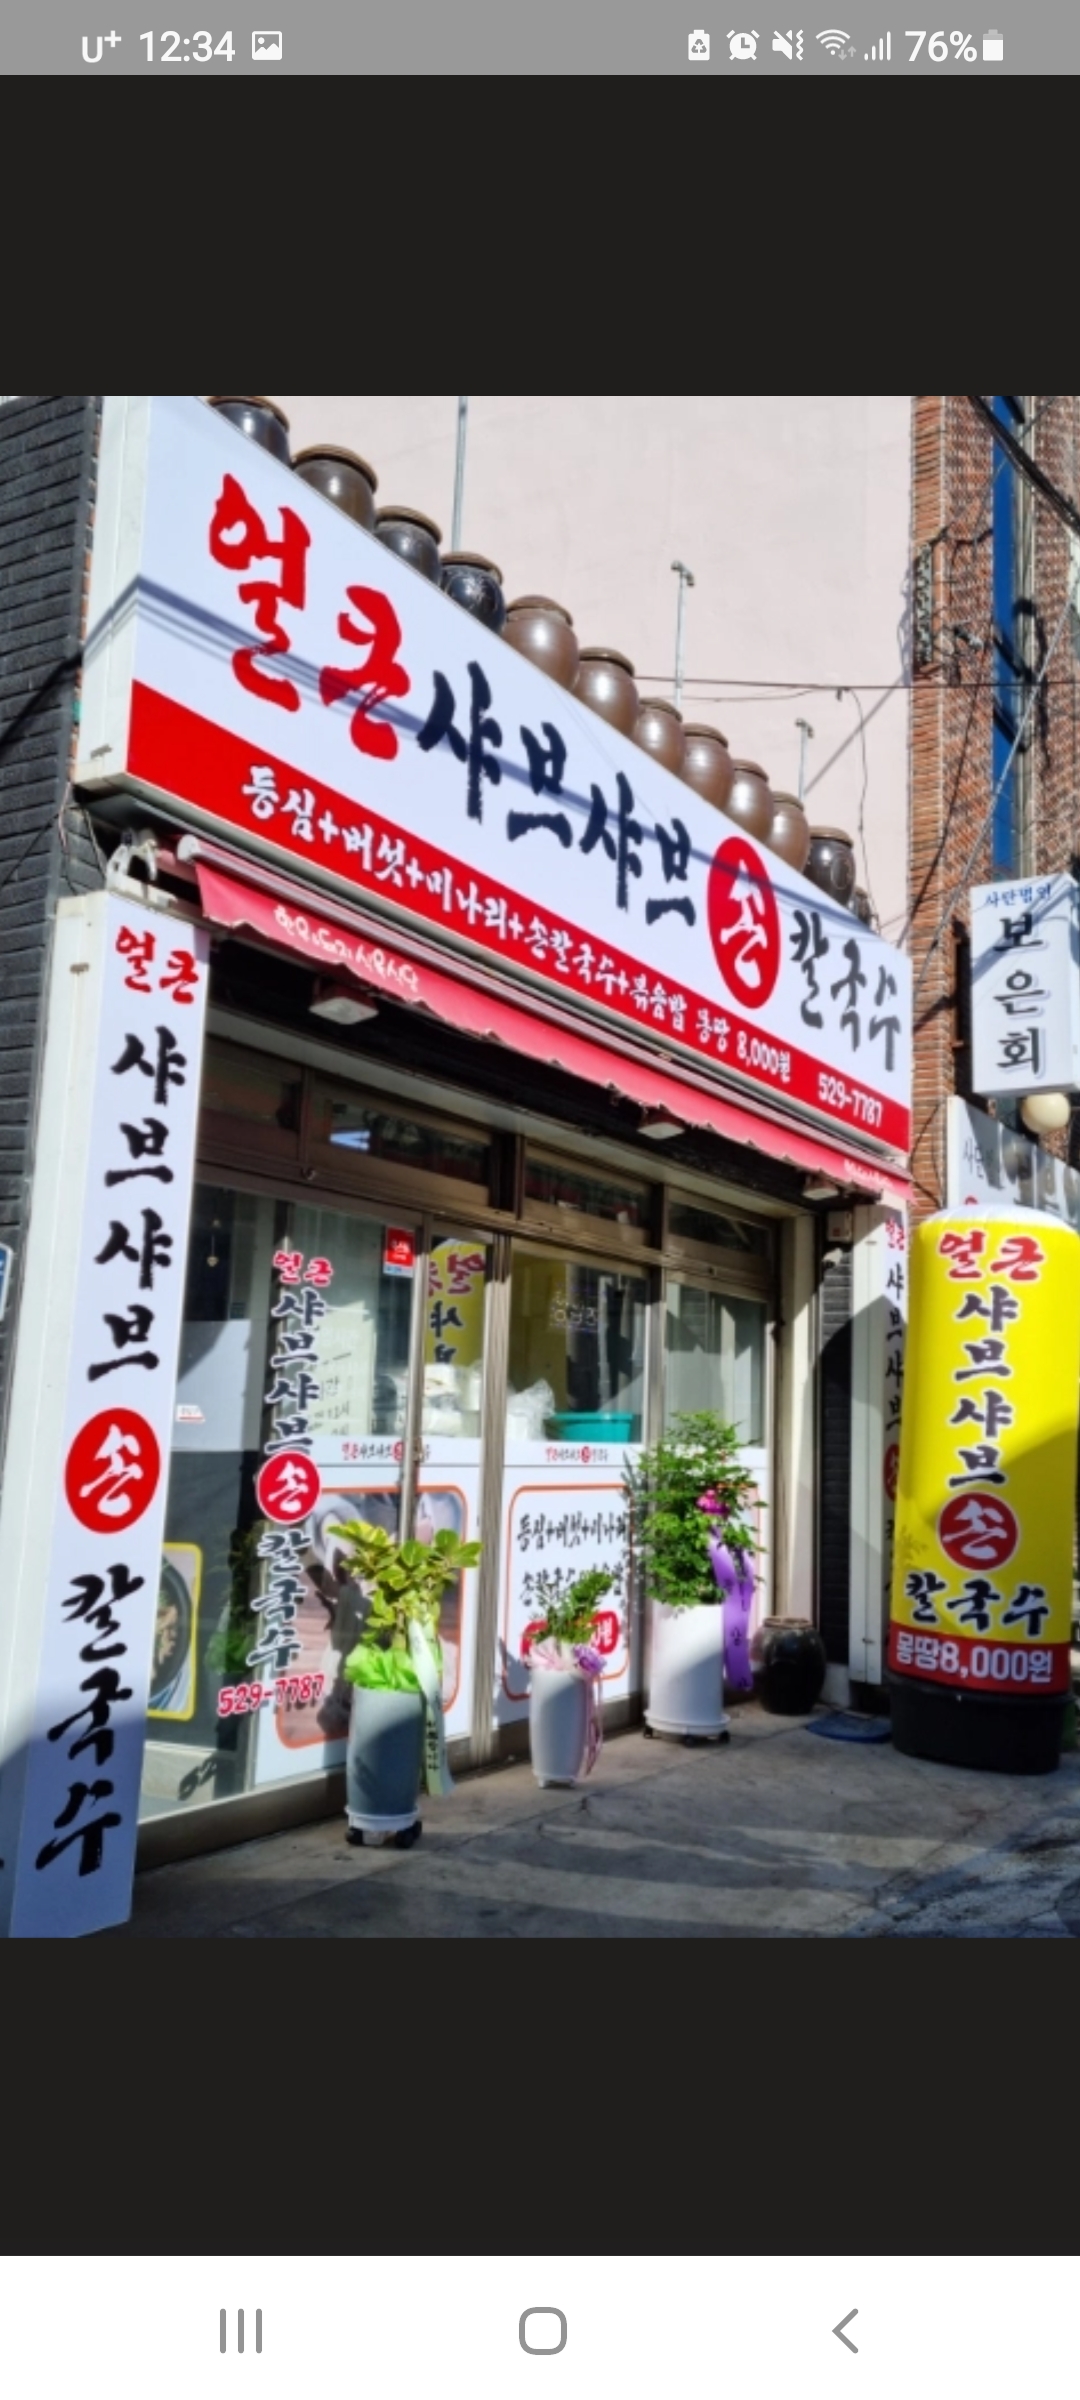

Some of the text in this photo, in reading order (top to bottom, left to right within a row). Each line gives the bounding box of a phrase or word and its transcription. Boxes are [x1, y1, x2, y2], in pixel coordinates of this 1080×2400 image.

[209, 473, 411, 761] 얼큰
[416, 661, 695, 926] 샤브샤브
[789, 909, 901, 1072] 칼국수
[116, 926, 199, 1004] 얼큰
[992, 912, 1046, 1075] 보은회
[737, 1030, 791, 1084] 8,000원
[818, 1071, 882, 1127] 529-7787
[87, 1025, 188, 1382] 샤브샤브
[272, 1250, 334, 1287] 얼큰
[938, 1229, 1045, 1281] 얼큰
[265, 1287, 326, 1454] 샤브샤브
[947, 1284, 1018, 1488] 샤브샤브
[246, 1531, 312, 1671] 칼국수
[906, 1572, 1049, 1637] 칼국수
[35, 1563, 145, 1877] 칼국수
[217, 1672, 326, 1717] 529-7787
